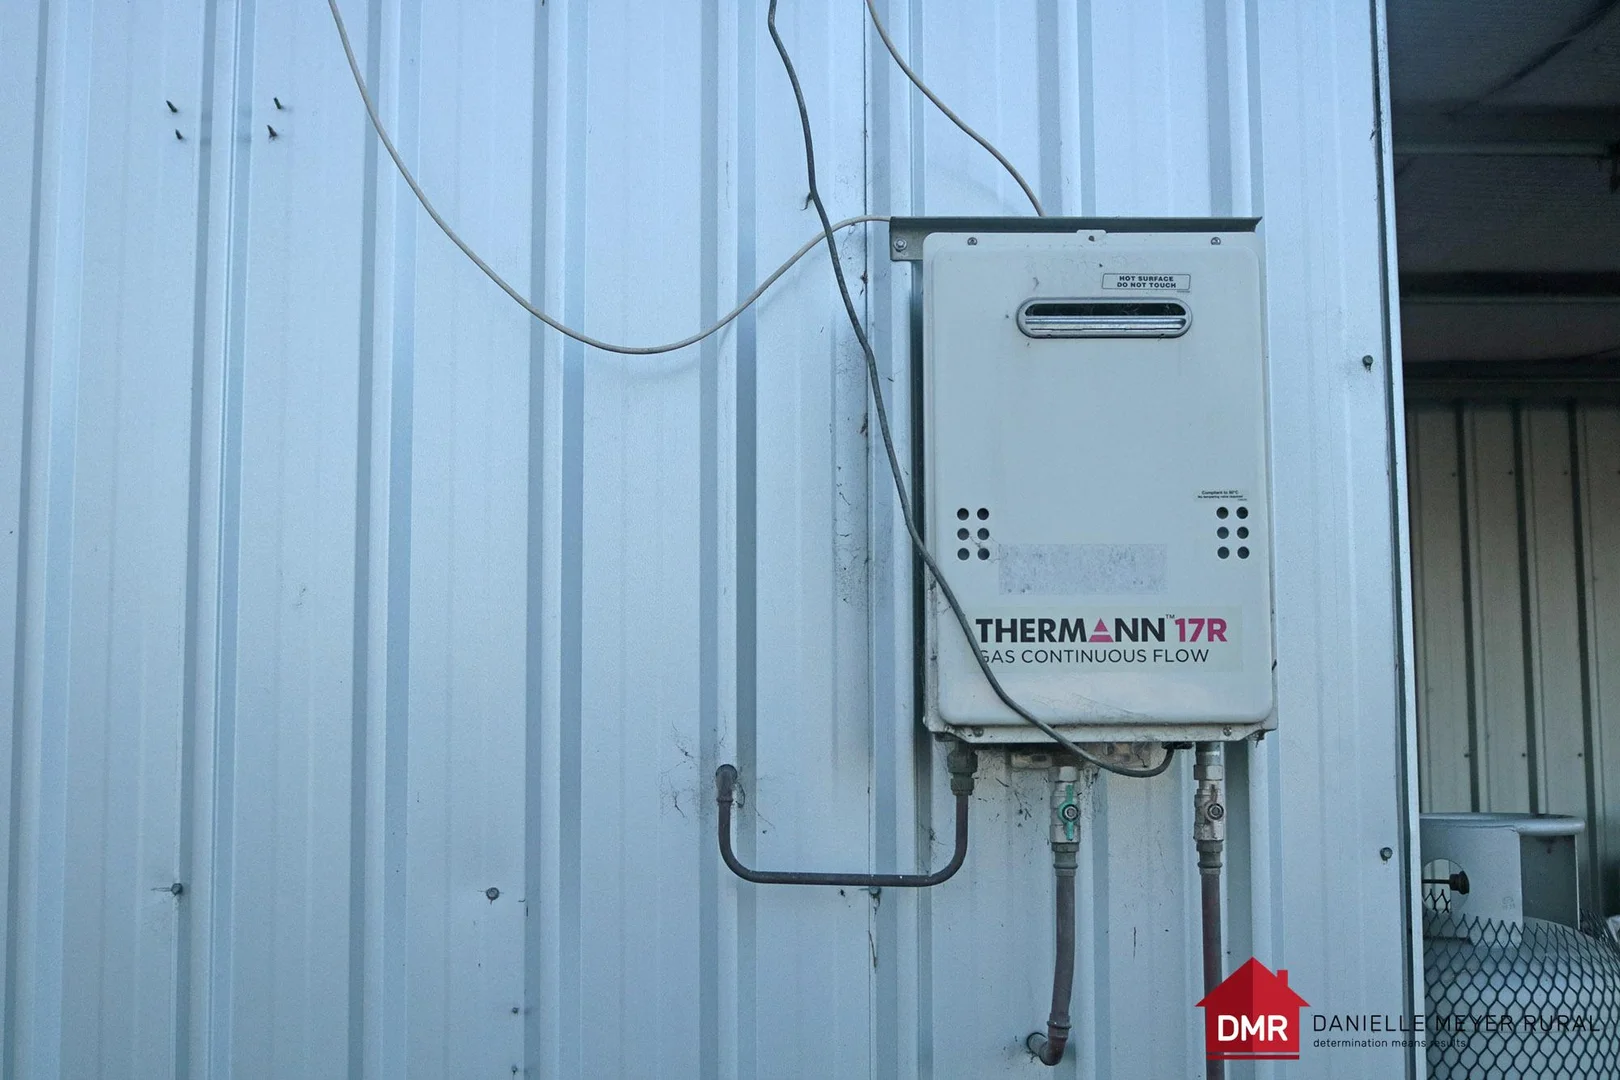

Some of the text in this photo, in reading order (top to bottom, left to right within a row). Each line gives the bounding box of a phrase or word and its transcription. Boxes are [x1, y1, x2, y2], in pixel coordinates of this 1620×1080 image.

[1175, 618, 1228, 643] 17R
[1021, 648, 1147, 664] CONTINUOUS
[1153, 648, 1210, 663] FLOW
